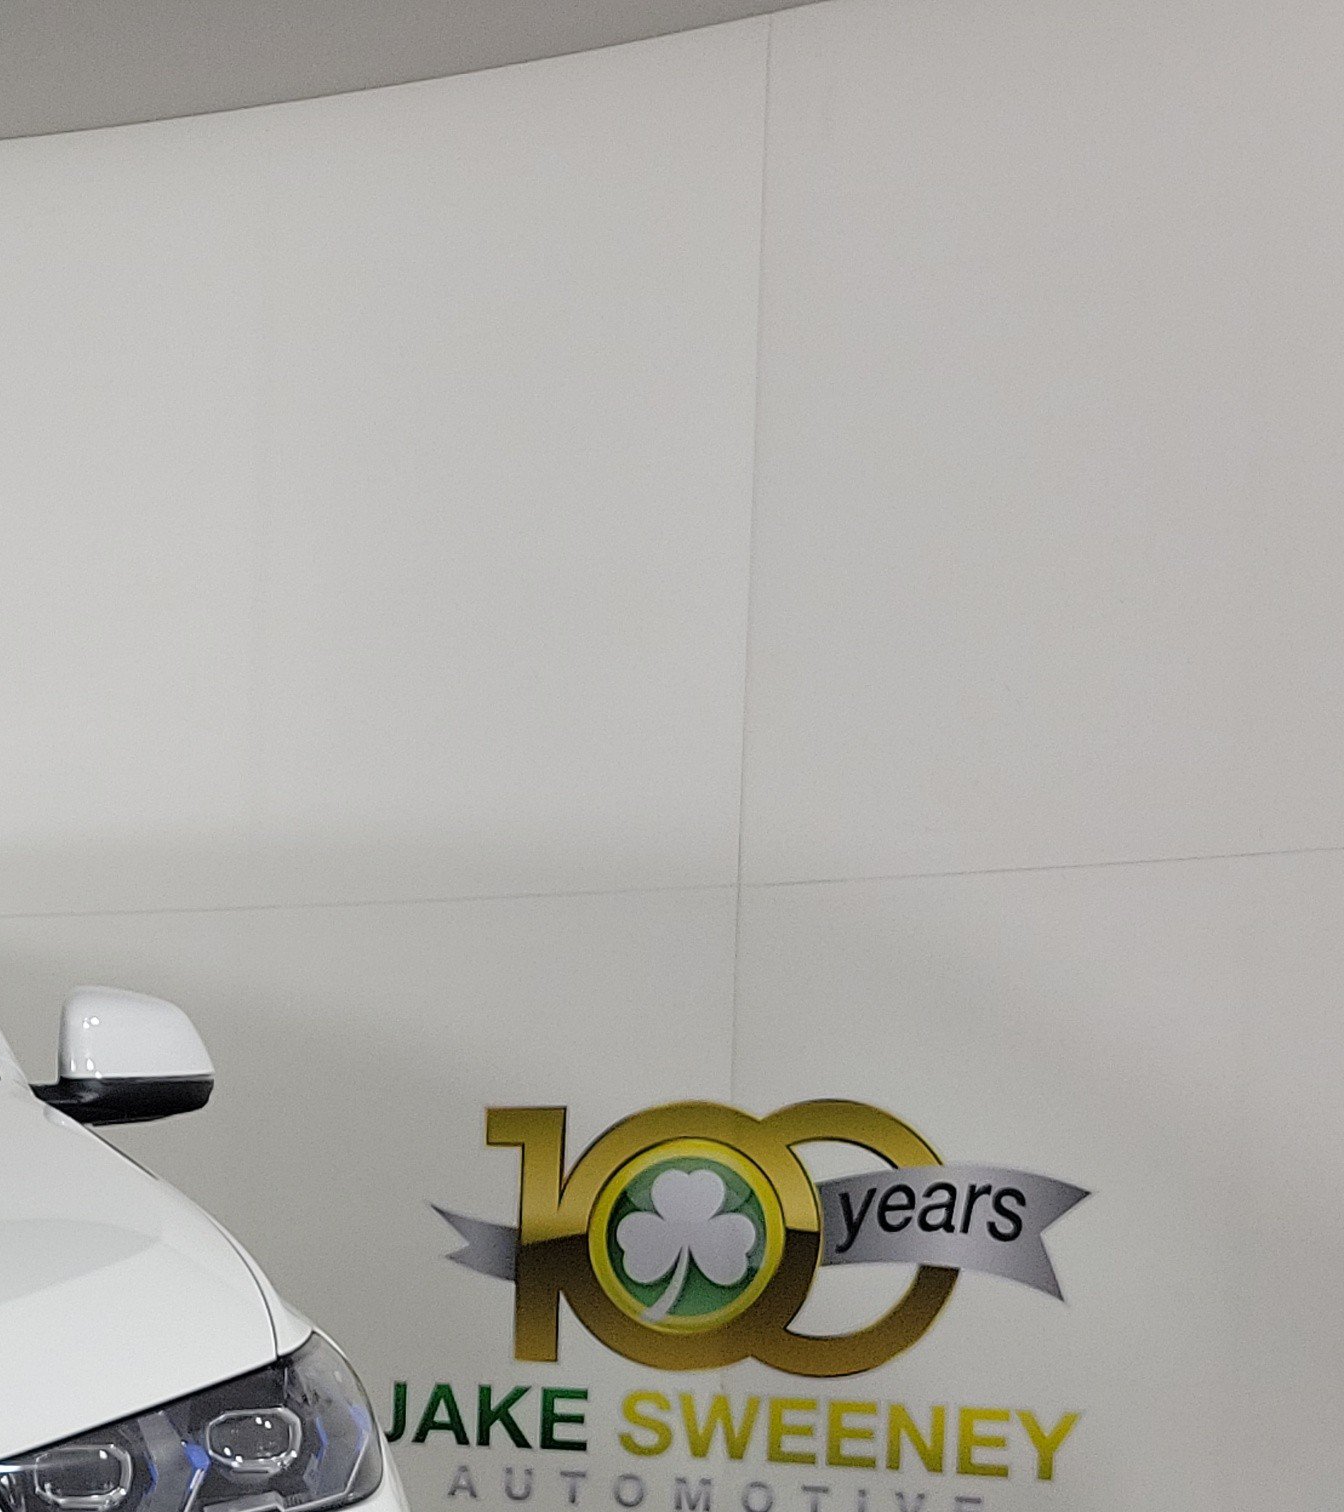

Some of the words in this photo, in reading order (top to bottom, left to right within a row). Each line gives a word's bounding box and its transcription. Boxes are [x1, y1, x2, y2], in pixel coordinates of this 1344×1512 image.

[485, 1098, 959, 1378] 100
[836, 1180, 1029, 1252] years
[385, 1380, 590, 1452] JAKE
[617, 1389, 1083, 1482] SWEENEY
